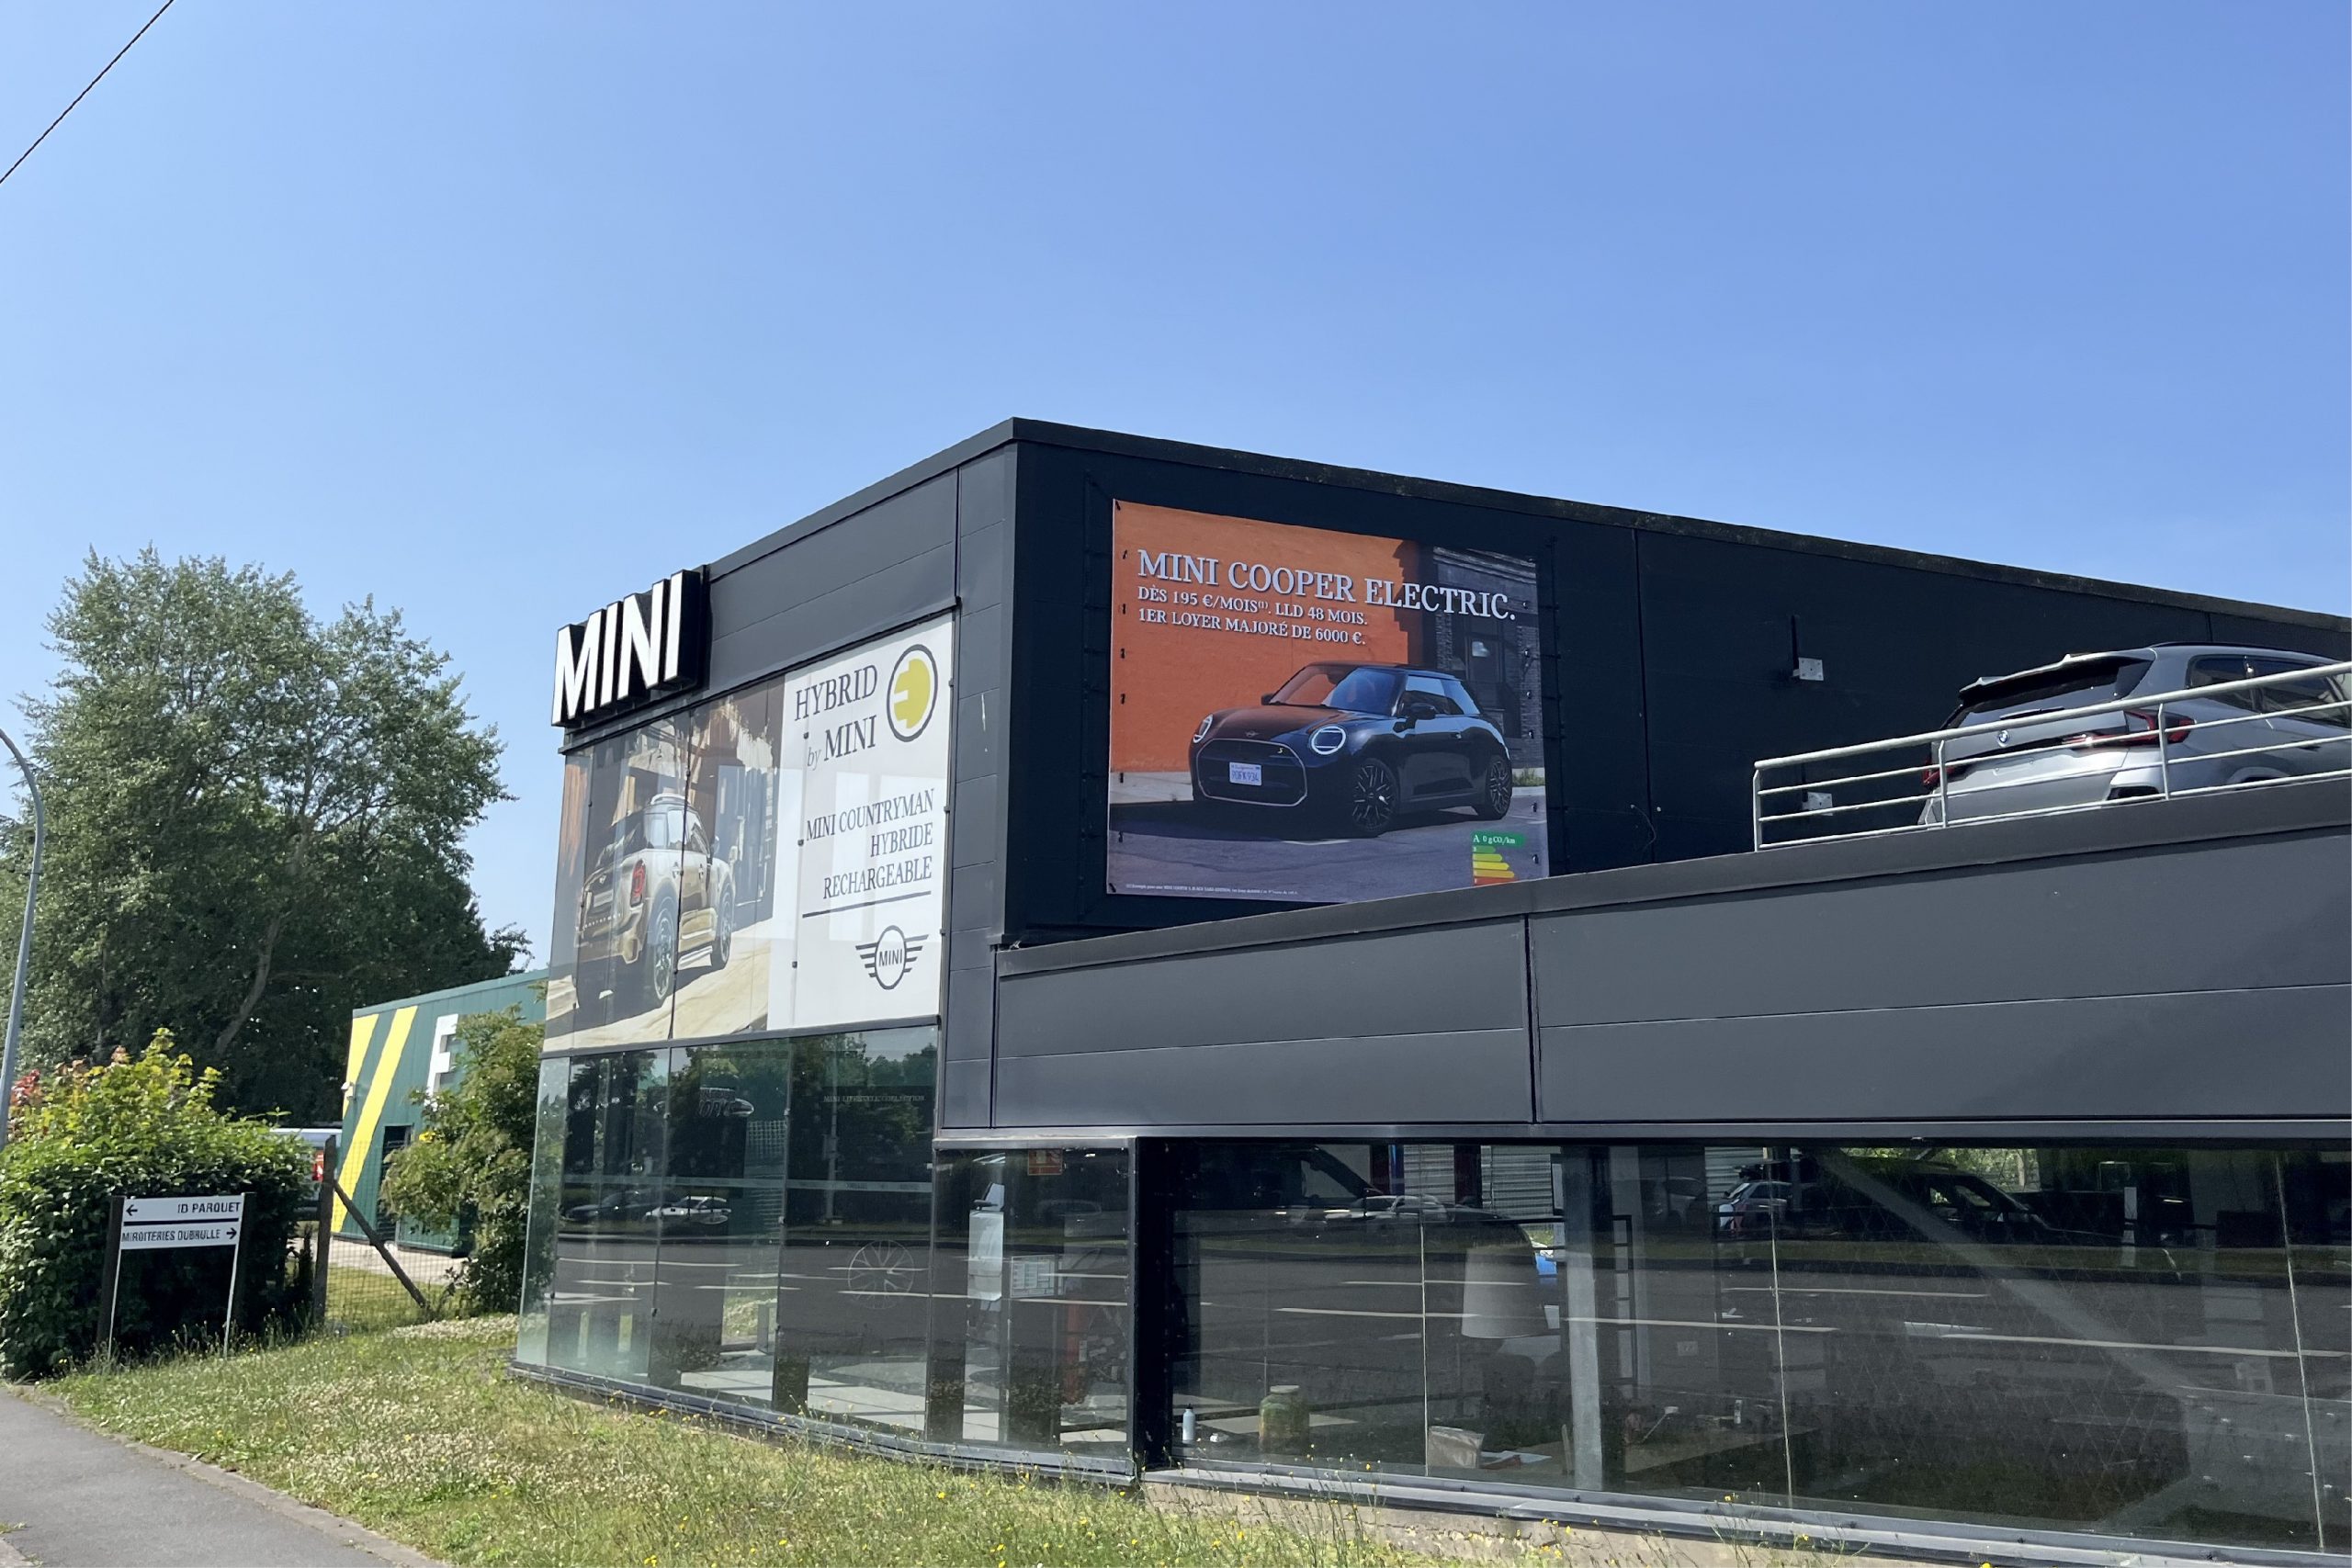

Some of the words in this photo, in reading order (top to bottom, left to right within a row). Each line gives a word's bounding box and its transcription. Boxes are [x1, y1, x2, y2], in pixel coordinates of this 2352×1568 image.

[1137, 549, 1219, 585] MINI
[1227, 561, 1357, 603] COOPER
[1364, 578, 1516, 620] ELECTRIC.
[1137, 584, 1167, 603] DÈS
[1172, 591, 1198, 605] 195
[1275, 603, 1304, 618] LLD
[1307, 606, 1324, 620] 48
[1328, 608, 1368, 625] MOIS.
[1138, 608, 1167, 623] 1ER
[1171, 611, 1221, 629] LOYER
[1226, 617, 1288, 637] MAJORÉ
[1292, 625, 1311, 639] DE
[1315, 628, 1349, 643] 6000
[1352, 631, 1366, 645] €.
[552, 571, 684, 725] MINI
[794, 664, 878, 721] HYBRID
[807, 747, 822, 771] by
[824, 715, 877, 761] MINI
[806, 814, 836, 841] MINI
[839, 788, 934, 833] COUNTRYMAN
[870, 822, 933, 857] HYBRIDE
[1473, 834, 1480, 843] A
[823, 856, 933, 899] RECHARGEABLE
[878, 949, 903, 966] MINI
[177, 1203, 188, 1213] ID
[192, 1201, 242, 1213] PARQUET
[177, 1229, 220, 1241] DUBRULLE
